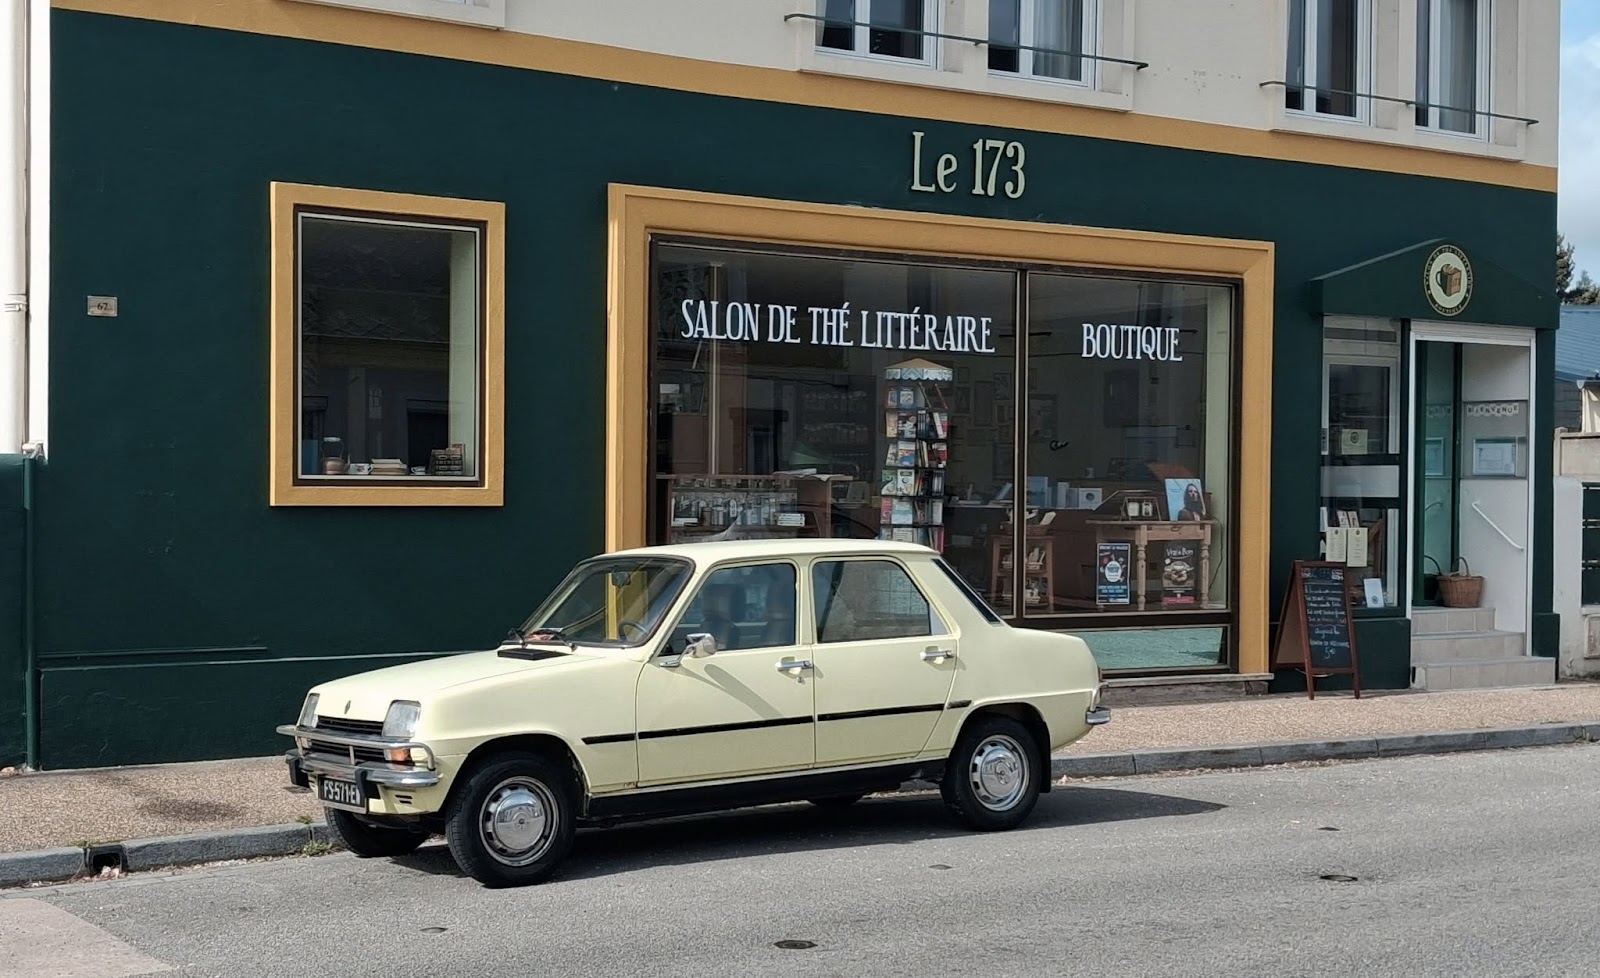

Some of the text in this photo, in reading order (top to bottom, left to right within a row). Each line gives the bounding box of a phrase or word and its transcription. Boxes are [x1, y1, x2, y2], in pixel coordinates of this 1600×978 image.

[911, 131, 1026, 199] Le 173
[97, 302, 108, 311] 67
[681, 299, 995, 353] SALON DE THÉ LITTÉRAIRE
[1081, 323, 1183, 362] BOUTIQUE
[1467, 404, 1519, 415] BIENVENUE
